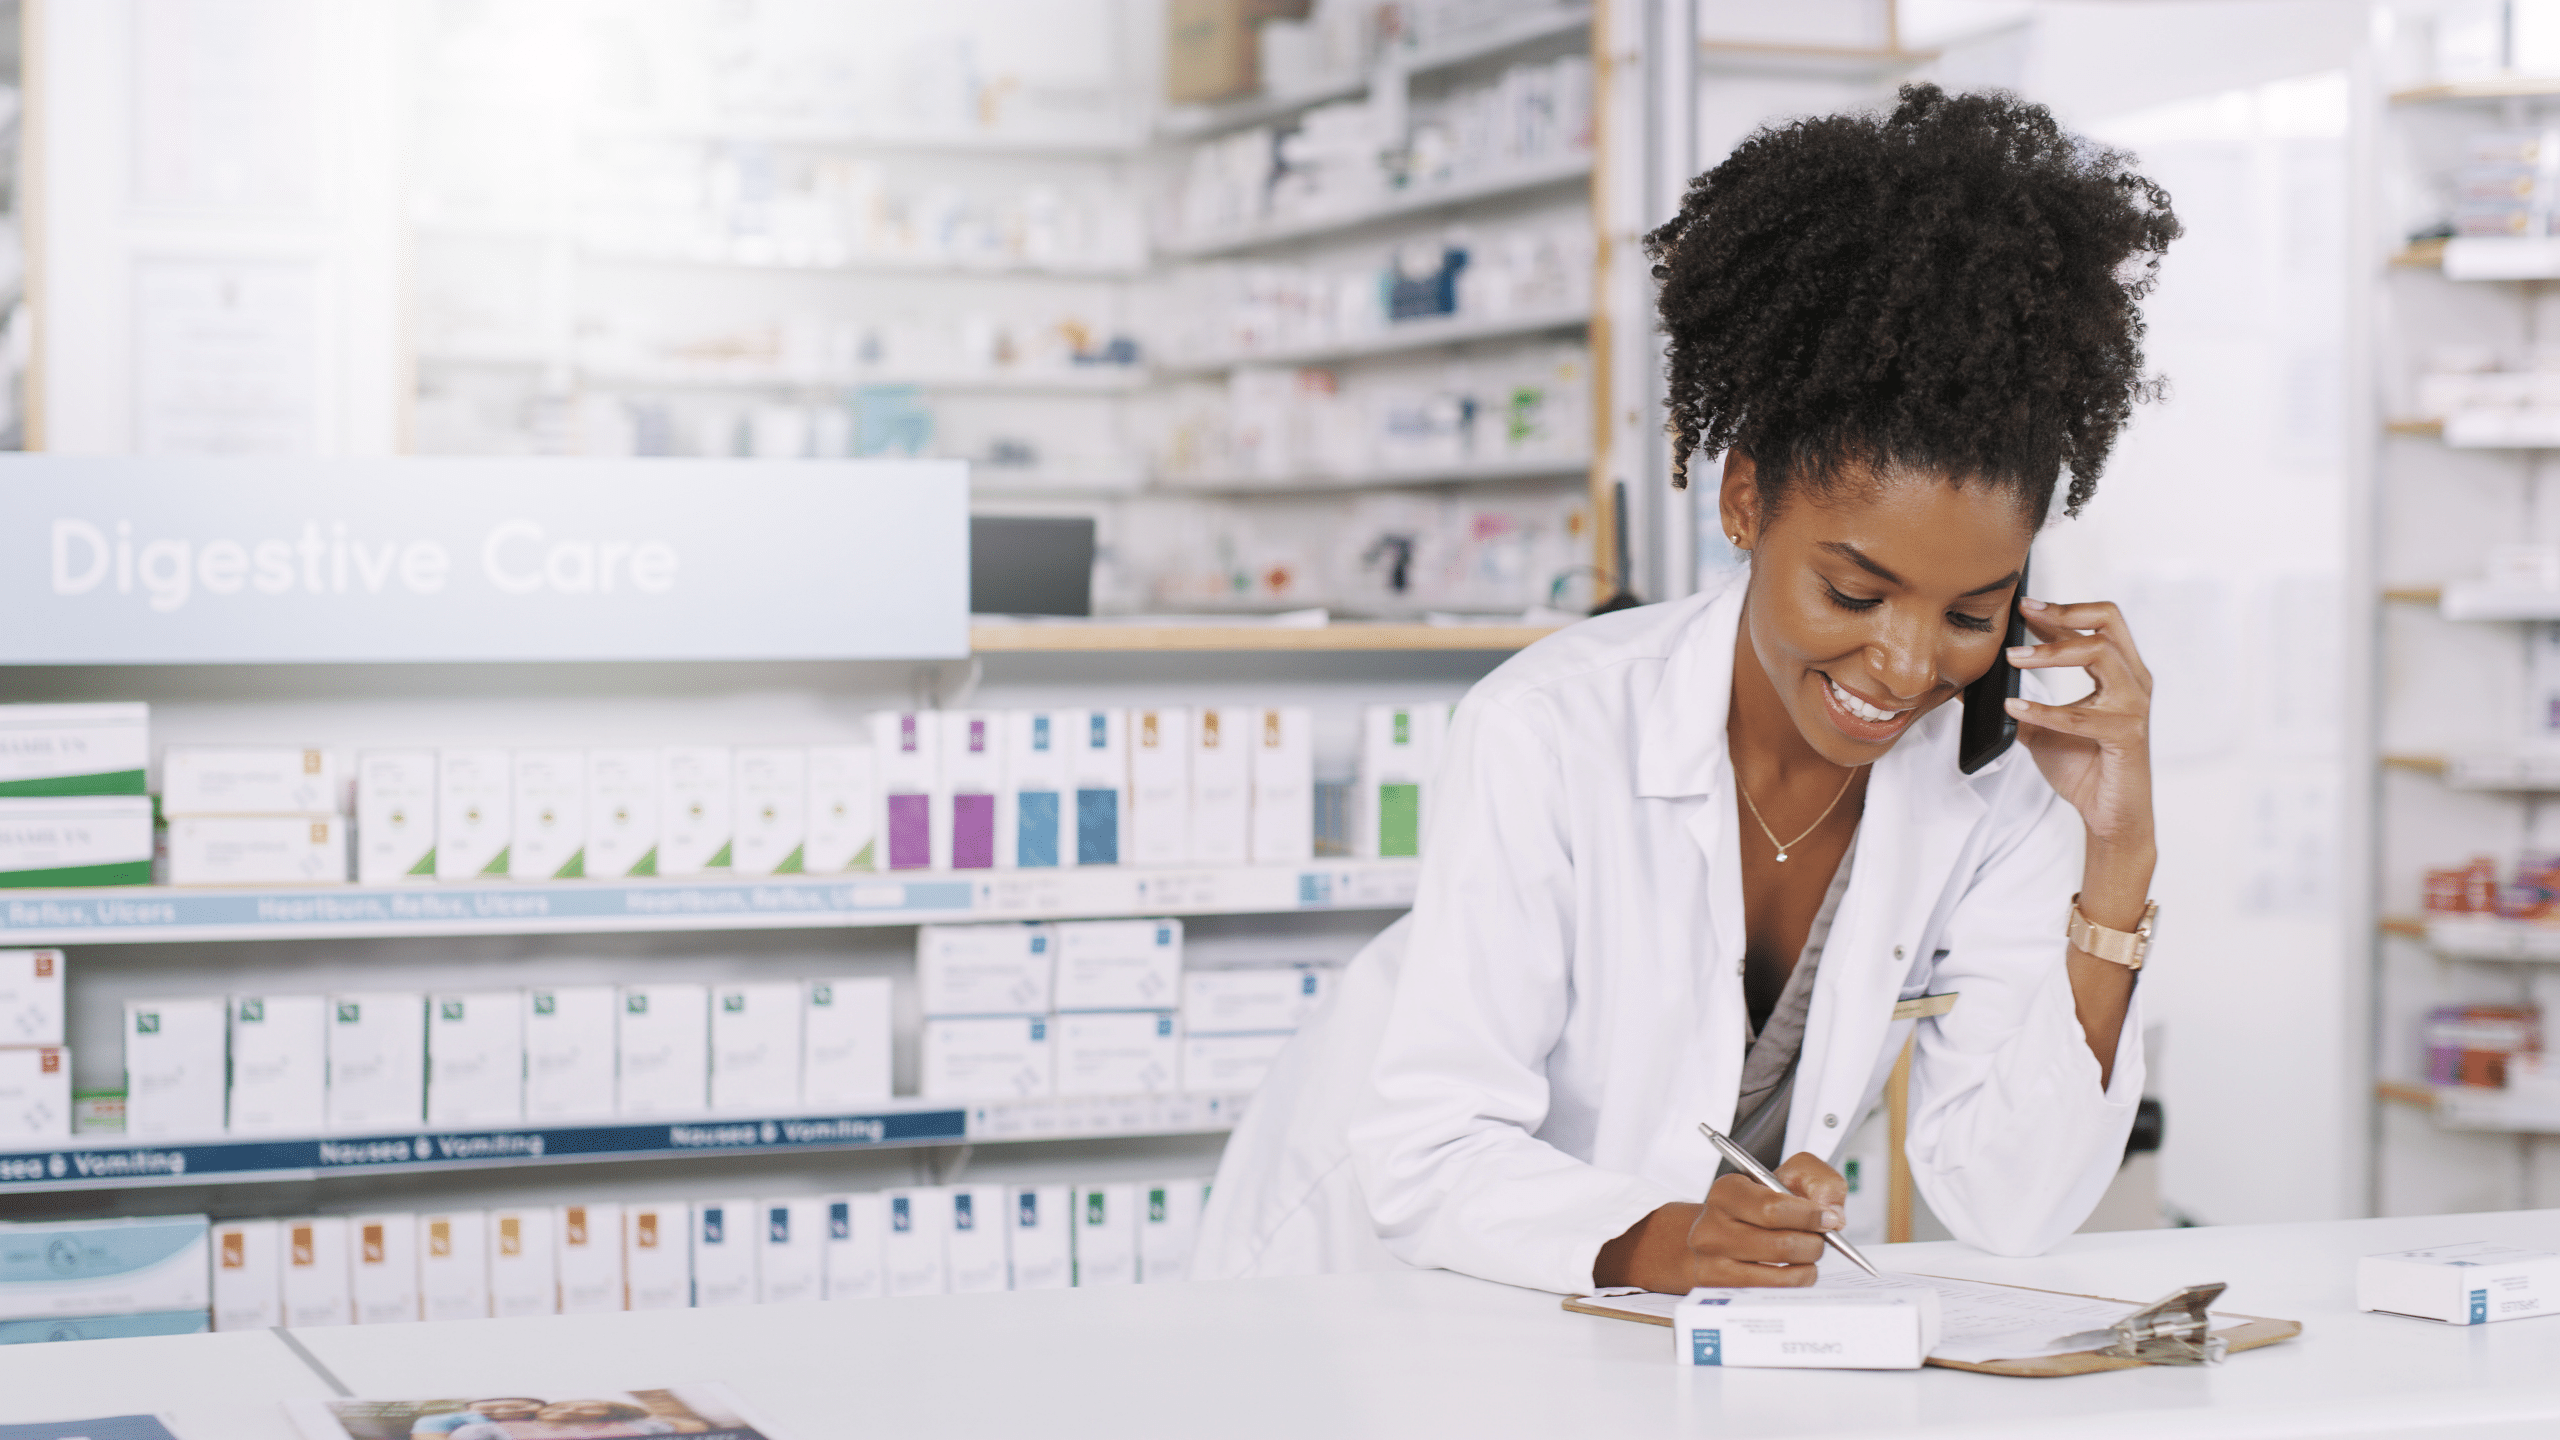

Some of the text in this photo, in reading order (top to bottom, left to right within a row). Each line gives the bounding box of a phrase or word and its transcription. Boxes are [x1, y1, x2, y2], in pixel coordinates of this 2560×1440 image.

[51, 517, 680, 612] Digestive Care
[9, 899, 175, 926] Reflux, Ulcers
[257, 893, 548, 921] Heartburn, Reflux, Ulcers
[670, 1125, 756, 1146] Nausea
[783, 1119, 884, 1143] Vomiting
[319, 1134, 545, 1164] Nausea & Vomiting
[0, 1150, 185, 1179] sea & Vomiting
[1782, 1340, 1842, 1354] CAPSULES
